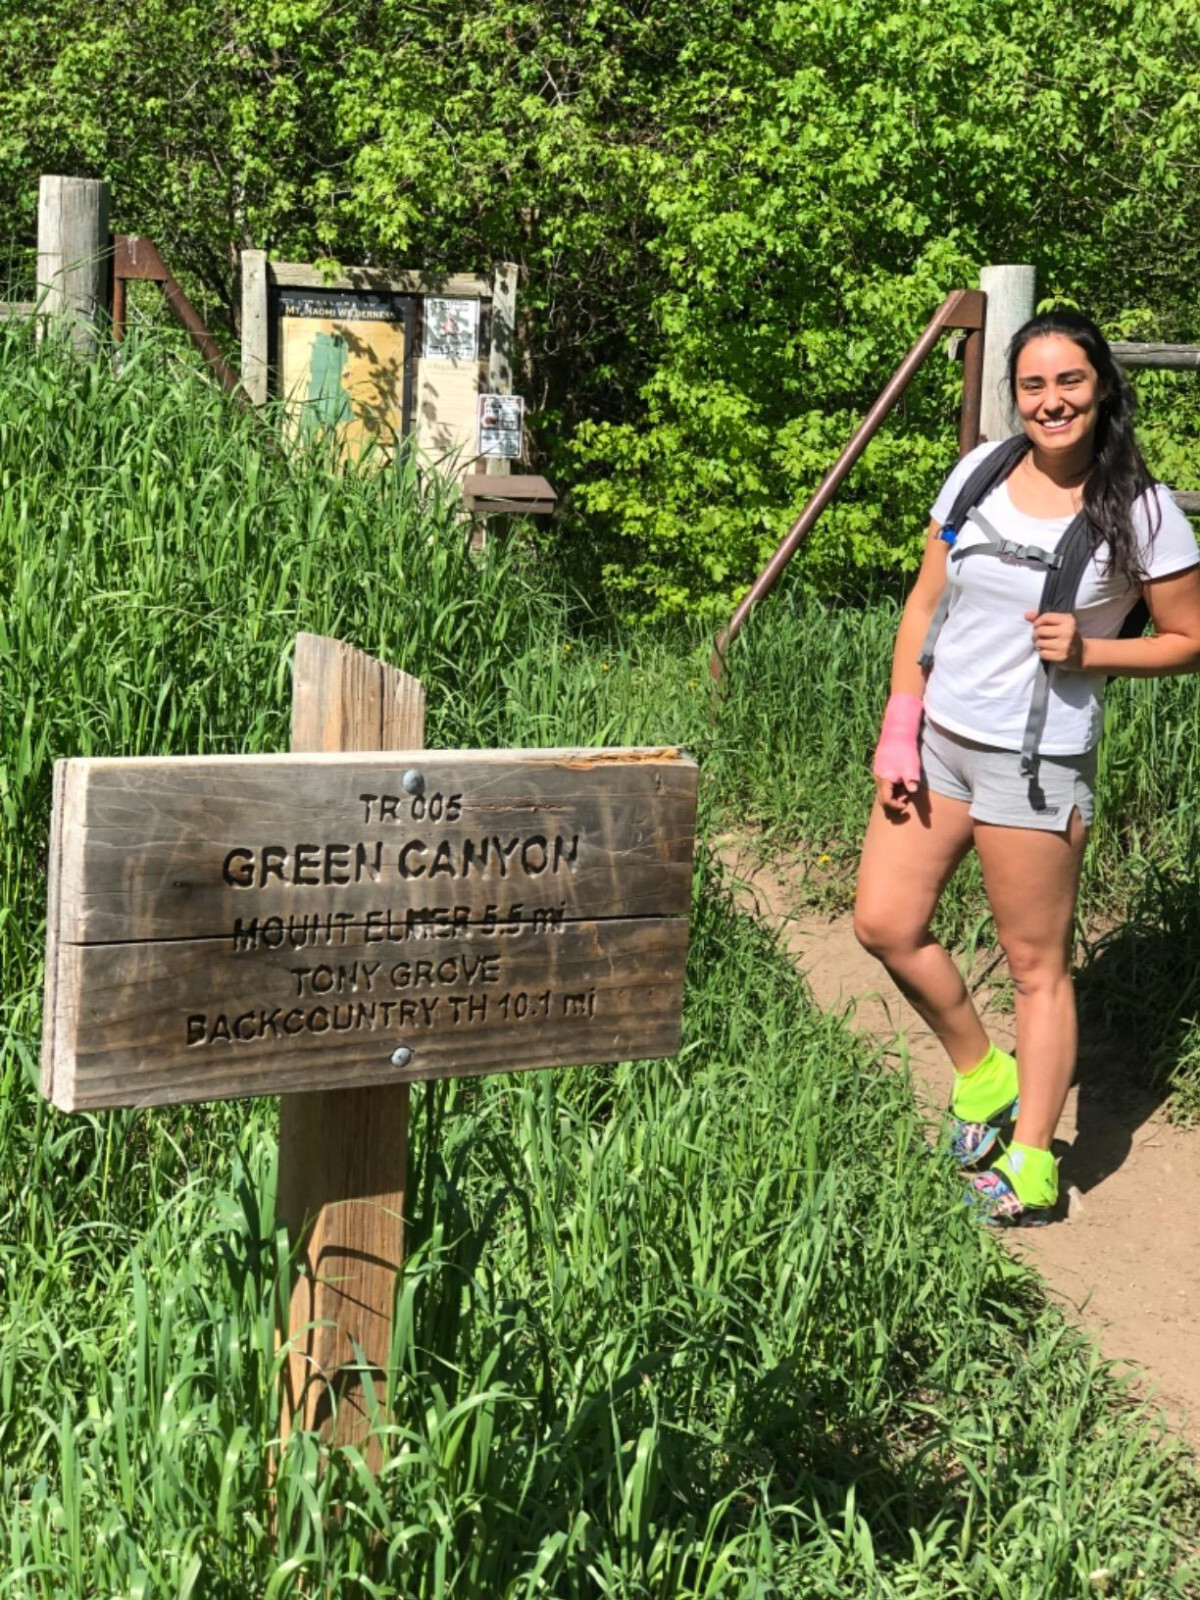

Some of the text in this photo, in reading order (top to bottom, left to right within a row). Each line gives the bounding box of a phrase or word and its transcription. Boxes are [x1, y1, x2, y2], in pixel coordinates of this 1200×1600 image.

[358, 792, 462, 824] TR 005
[222, 835, 579, 889] GREEN CANYON
[233, 901, 567, 951] MOUNT ELMER 5.5 mi
[290, 954, 501, 997] TONY GROVE
[186, 986, 597, 1047] BACKCOUNTRY TH 10.1 mi
